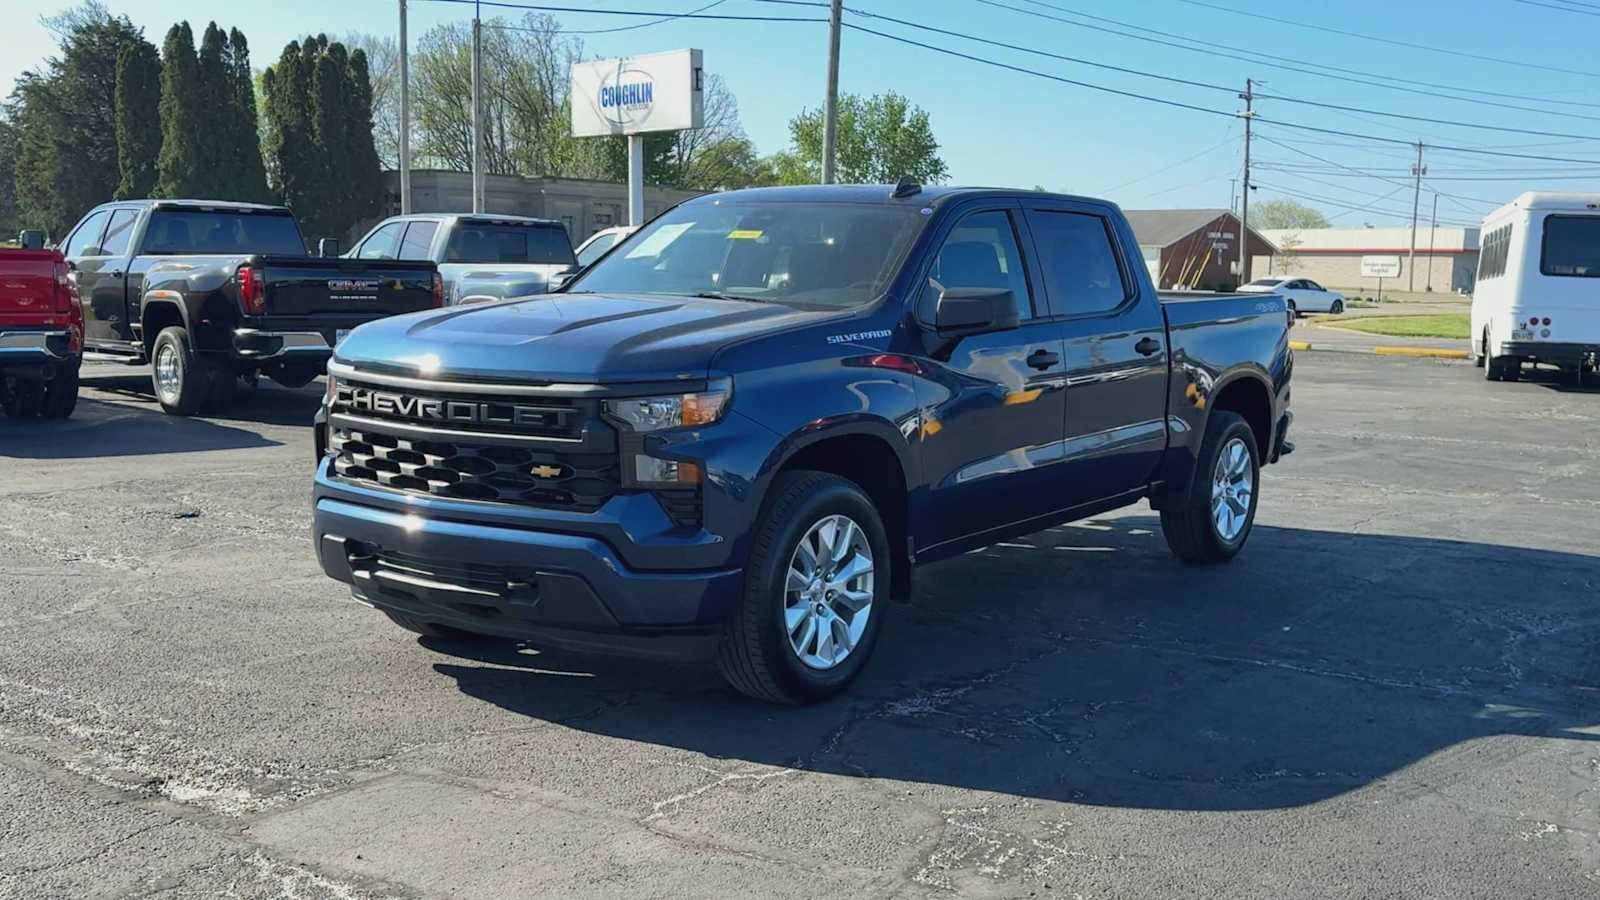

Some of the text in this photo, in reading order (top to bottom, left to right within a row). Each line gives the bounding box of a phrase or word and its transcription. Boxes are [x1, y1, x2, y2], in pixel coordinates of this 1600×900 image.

[601, 82, 653, 107] COUGHLIN
[328, 280, 378, 291] GMC
[826, 329, 892, 344] SILVERADO
[334, 385, 577, 427] CHEVROLET
